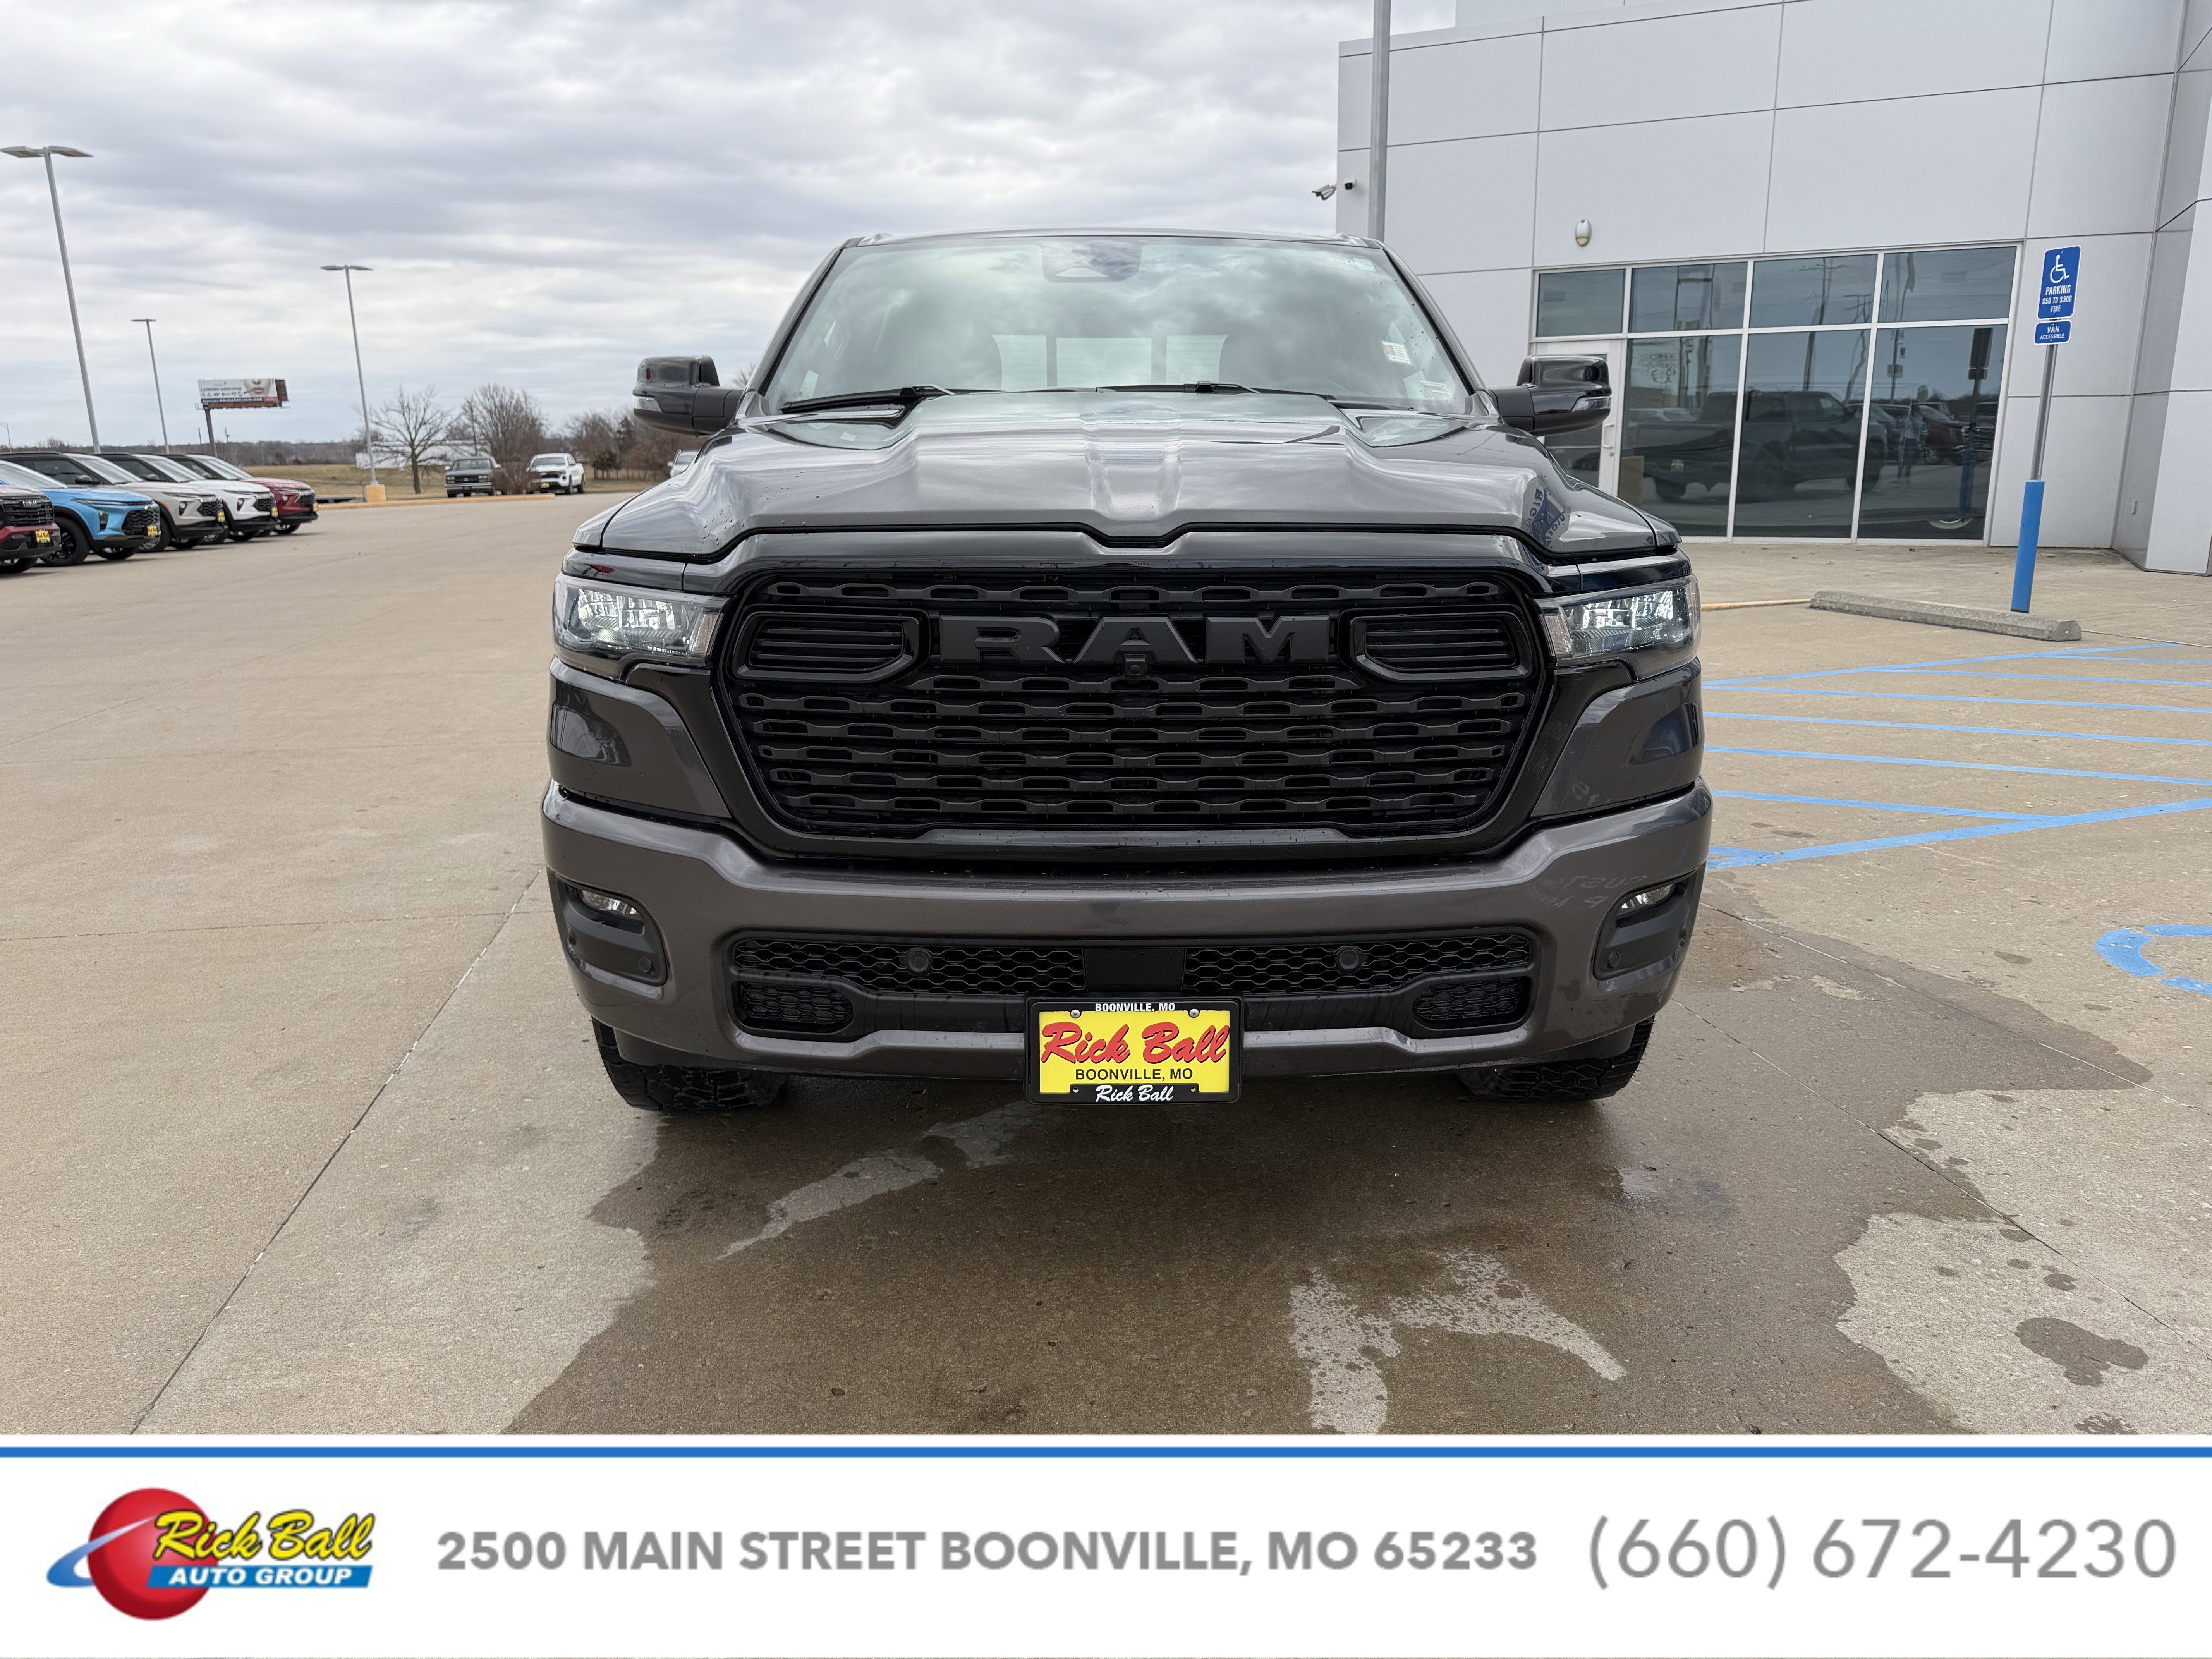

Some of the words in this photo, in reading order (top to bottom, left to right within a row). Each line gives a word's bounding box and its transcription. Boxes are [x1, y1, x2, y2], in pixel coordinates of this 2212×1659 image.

[2045, 284, 2071, 295] PARKING
[939, 615, 1330, 664] RAM
[1095, 1003, 1155, 1013] BOONVILLE,
[1159, 1003, 1175, 1012] MO
[1041, 1022, 1132, 1064] Rick
[1142, 1022, 1230, 1064] Ball
[1075, 1068, 1165, 1082] BOONVILLE,
[1170, 1068, 1193, 1079] MO
[1096, 1085, 1134, 1102] Rick
[1138, 1084, 1174, 1101] Ball
